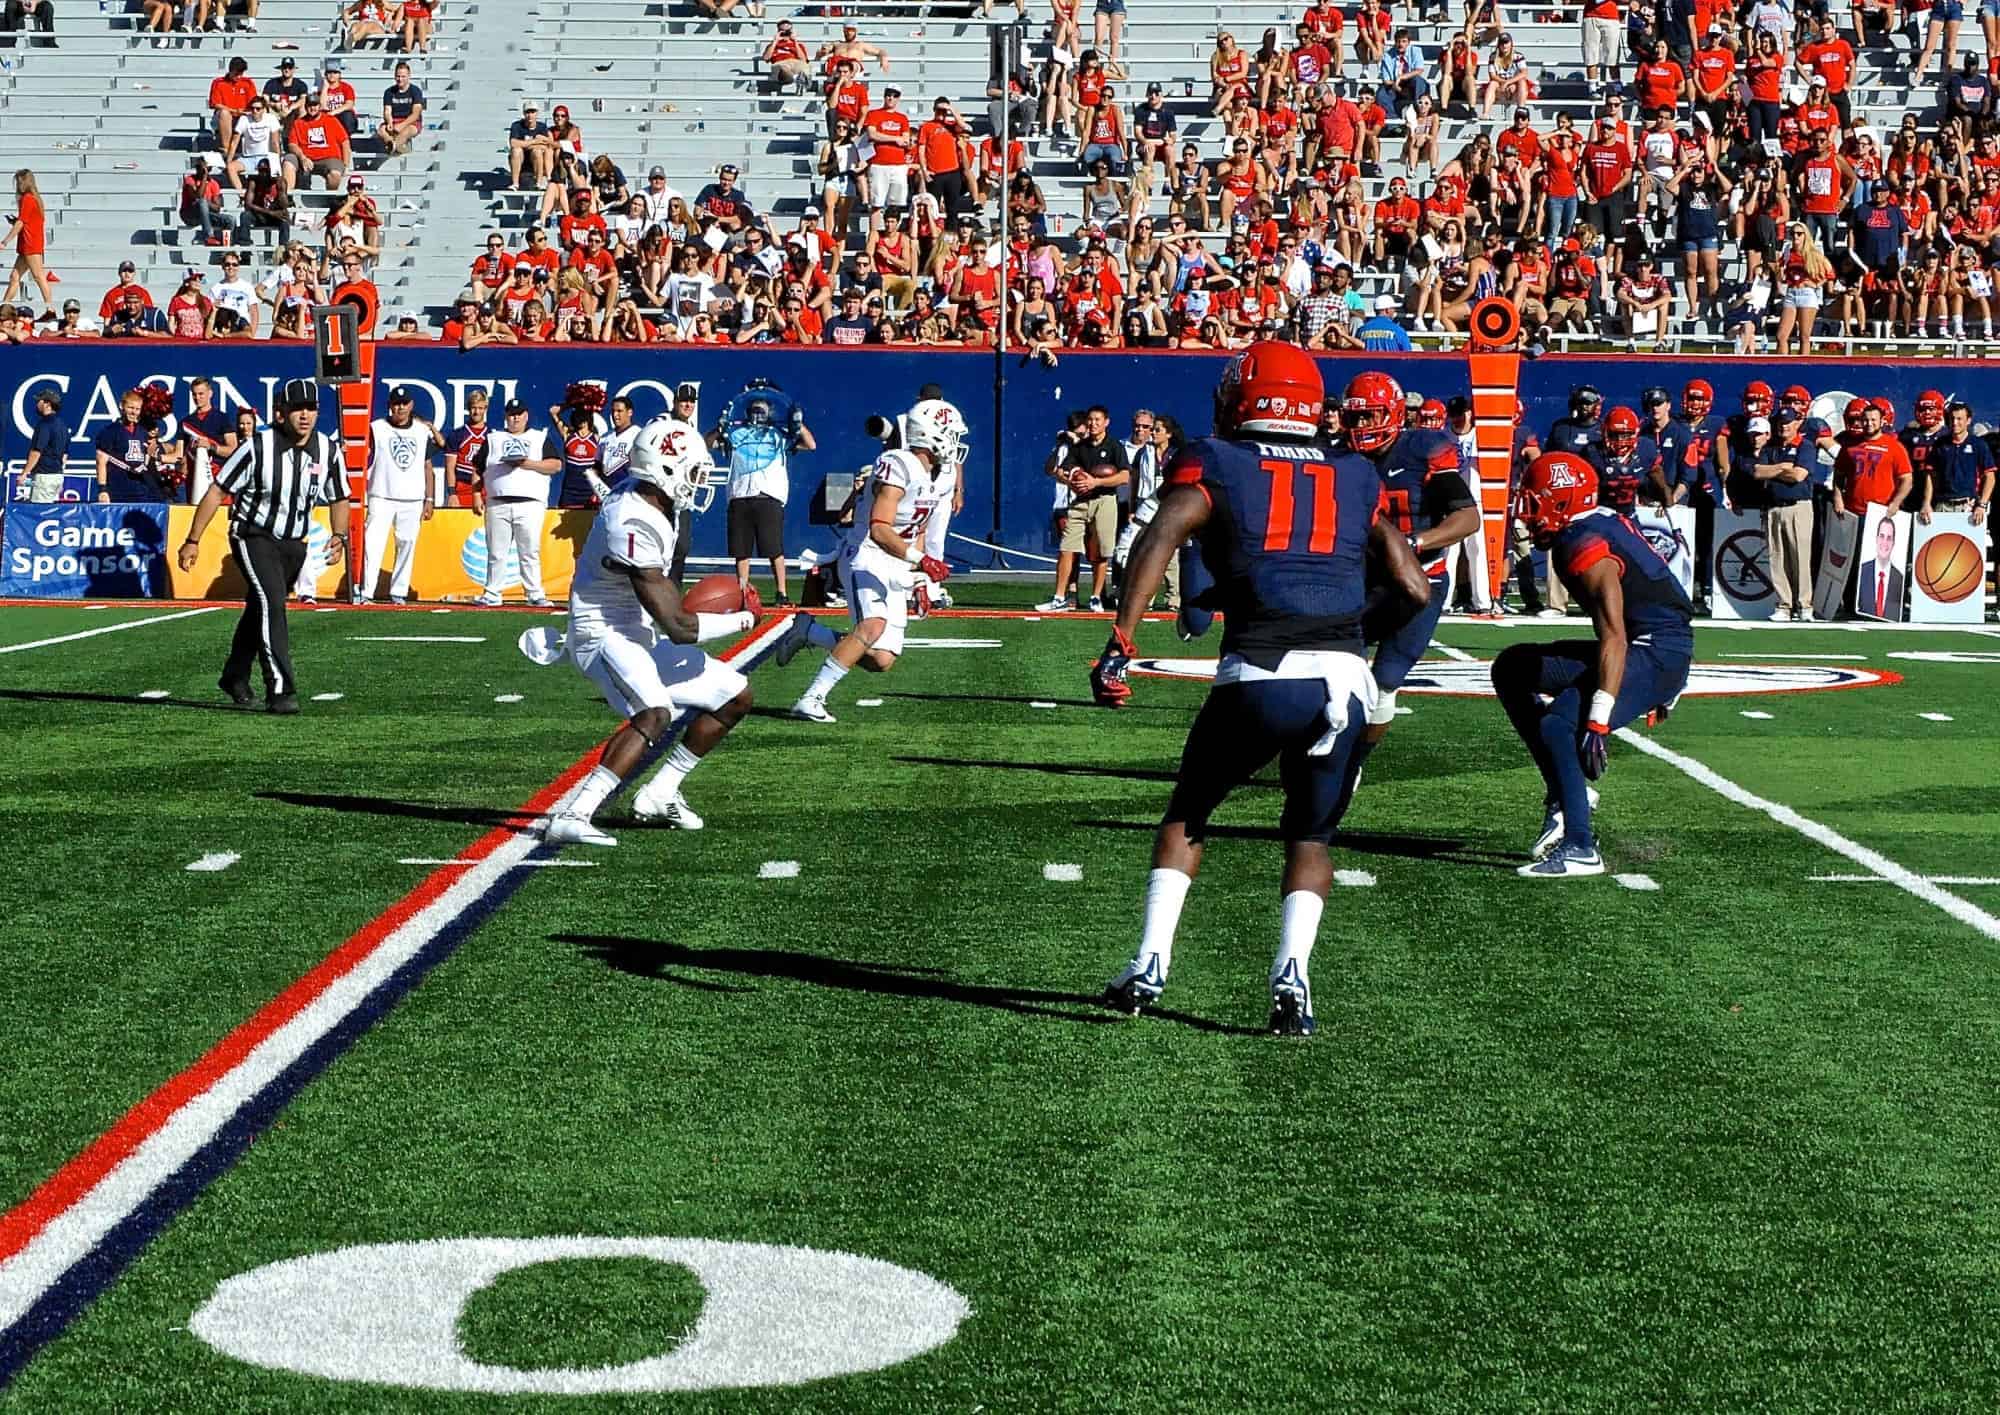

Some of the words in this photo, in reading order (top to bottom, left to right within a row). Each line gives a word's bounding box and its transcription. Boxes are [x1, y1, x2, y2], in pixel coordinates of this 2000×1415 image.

[324, 314, 345, 356] 1
[12, 374, 341, 442] CASIN
[125, 440, 145, 461] A
[398, 454, 409, 465] 12
[876, 458, 891, 481] 21
[1551, 463, 1576, 488] A
[1259, 459, 1338, 554] 11
[35, 519, 135, 548] Game
[627, 532, 635, 559] 1
[11, 547, 156, 582] Sponsor
[188, 1235, 973, 1394] 0
